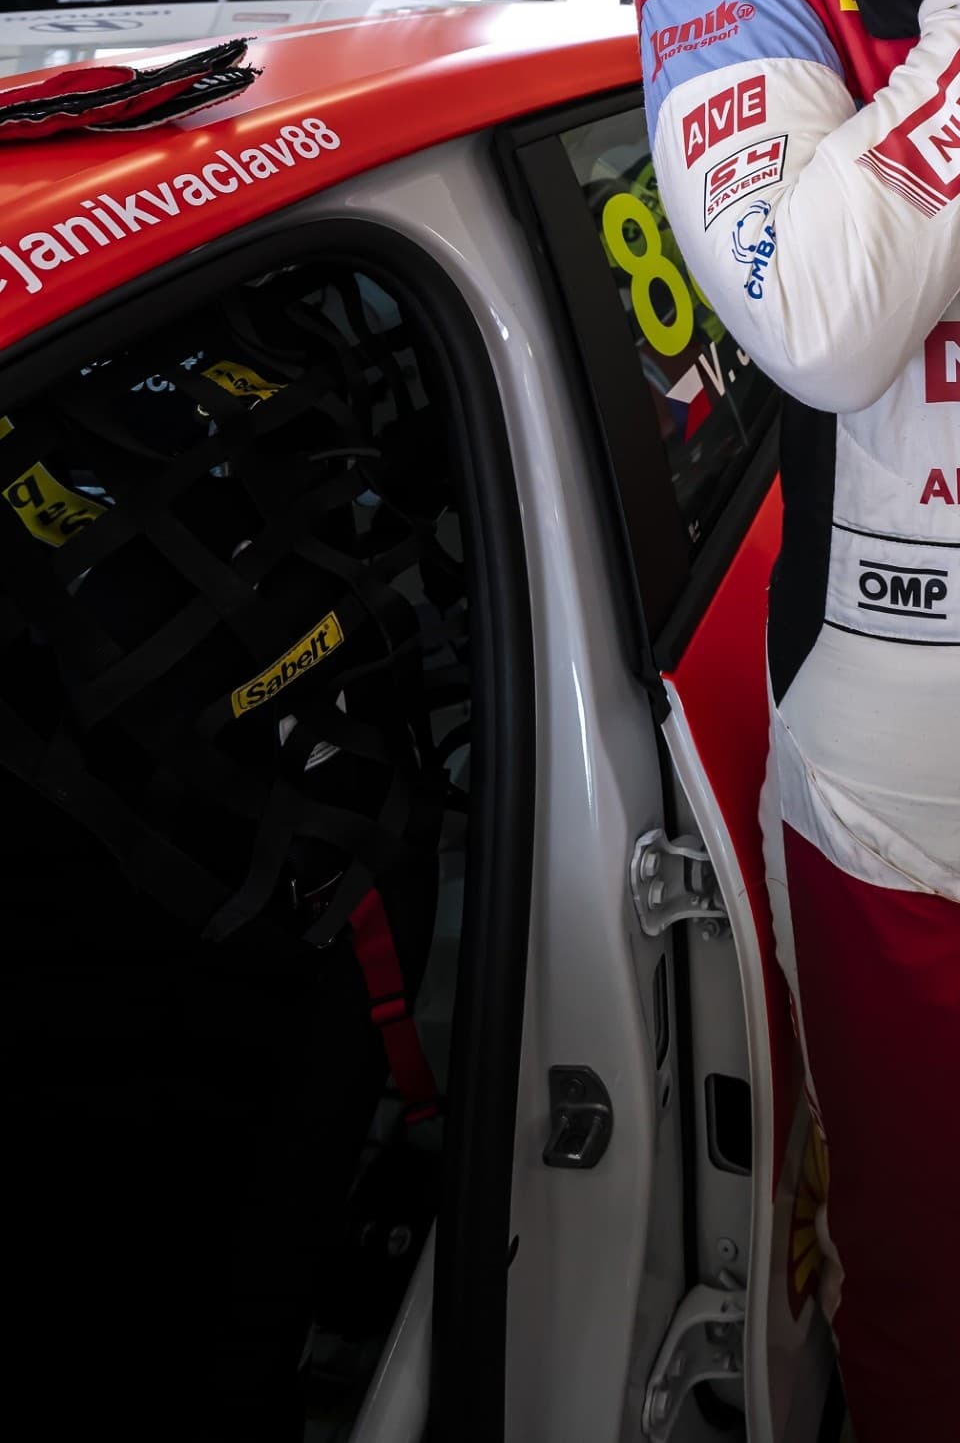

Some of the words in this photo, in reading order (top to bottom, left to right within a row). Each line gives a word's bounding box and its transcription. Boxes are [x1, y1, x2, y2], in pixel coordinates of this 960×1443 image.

[661, 24, 739, 62] motorsport
[686, 86, 763, 157] AVE
[0, 117, 342, 295] janikvaclav88
[707, 167, 778, 215] STAVEBNI
[602, 193, 694, 356] 8
[858, 570, 948, 610] OMP
[246, 629, 330, 706] Sabelt
